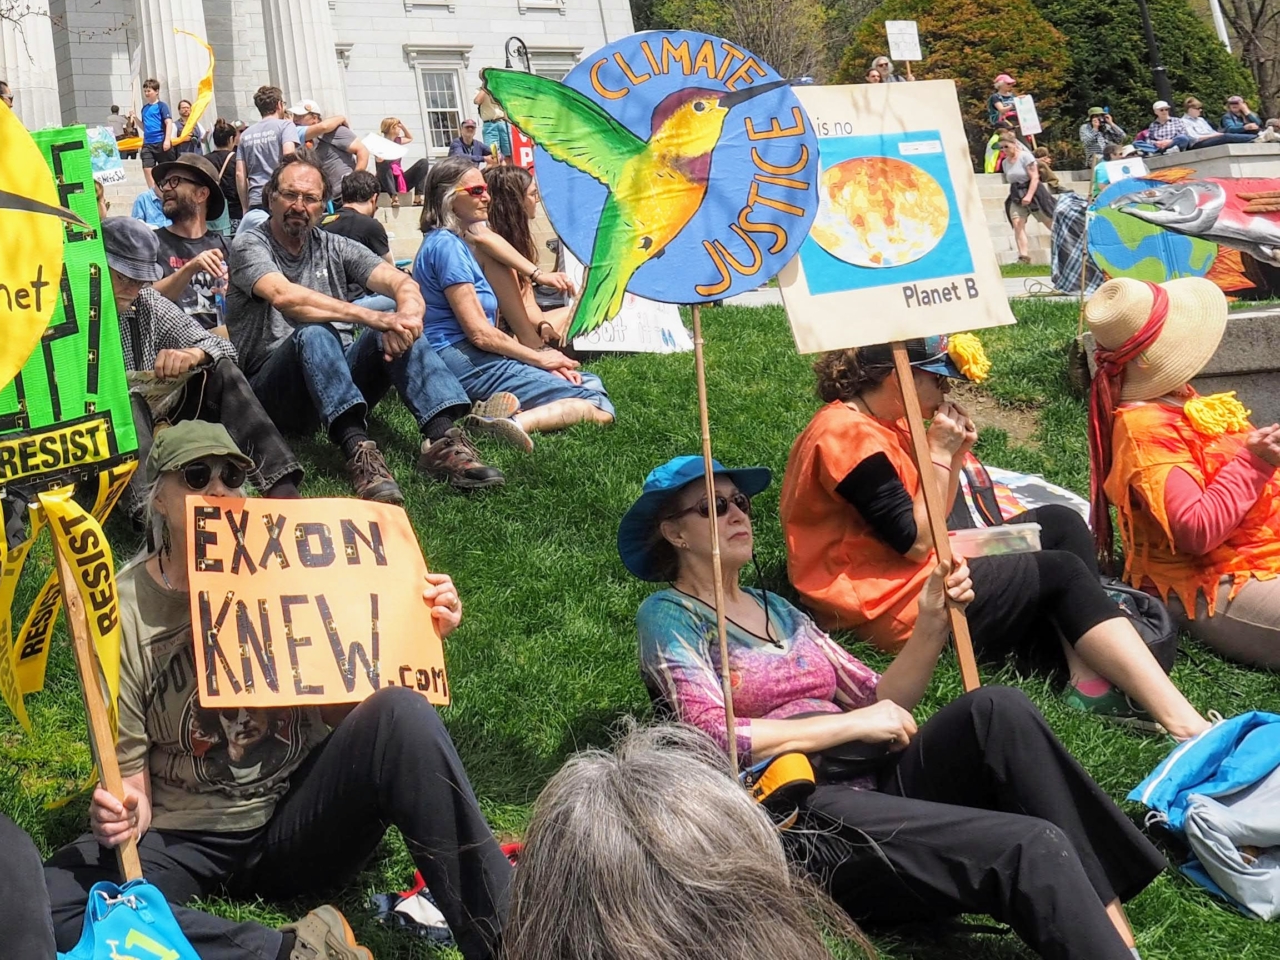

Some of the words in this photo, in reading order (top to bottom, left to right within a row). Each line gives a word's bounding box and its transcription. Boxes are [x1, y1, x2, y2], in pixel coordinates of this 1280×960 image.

[590, 37, 768, 100] CLIMATE
[816, 117, 830, 136] is
[834, 121, 853, 136] no
[695, 106, 811, 297] JUSTICE
[902, 281, 962, 308] Planet
[964, 277, 979, 299] B
[58, 512, 118, 637] RESIST
[194, 506, 388, 575] EXXON
[20, 581, 62, 661] RESIST
[198, 590, 380, 697] KNEW
